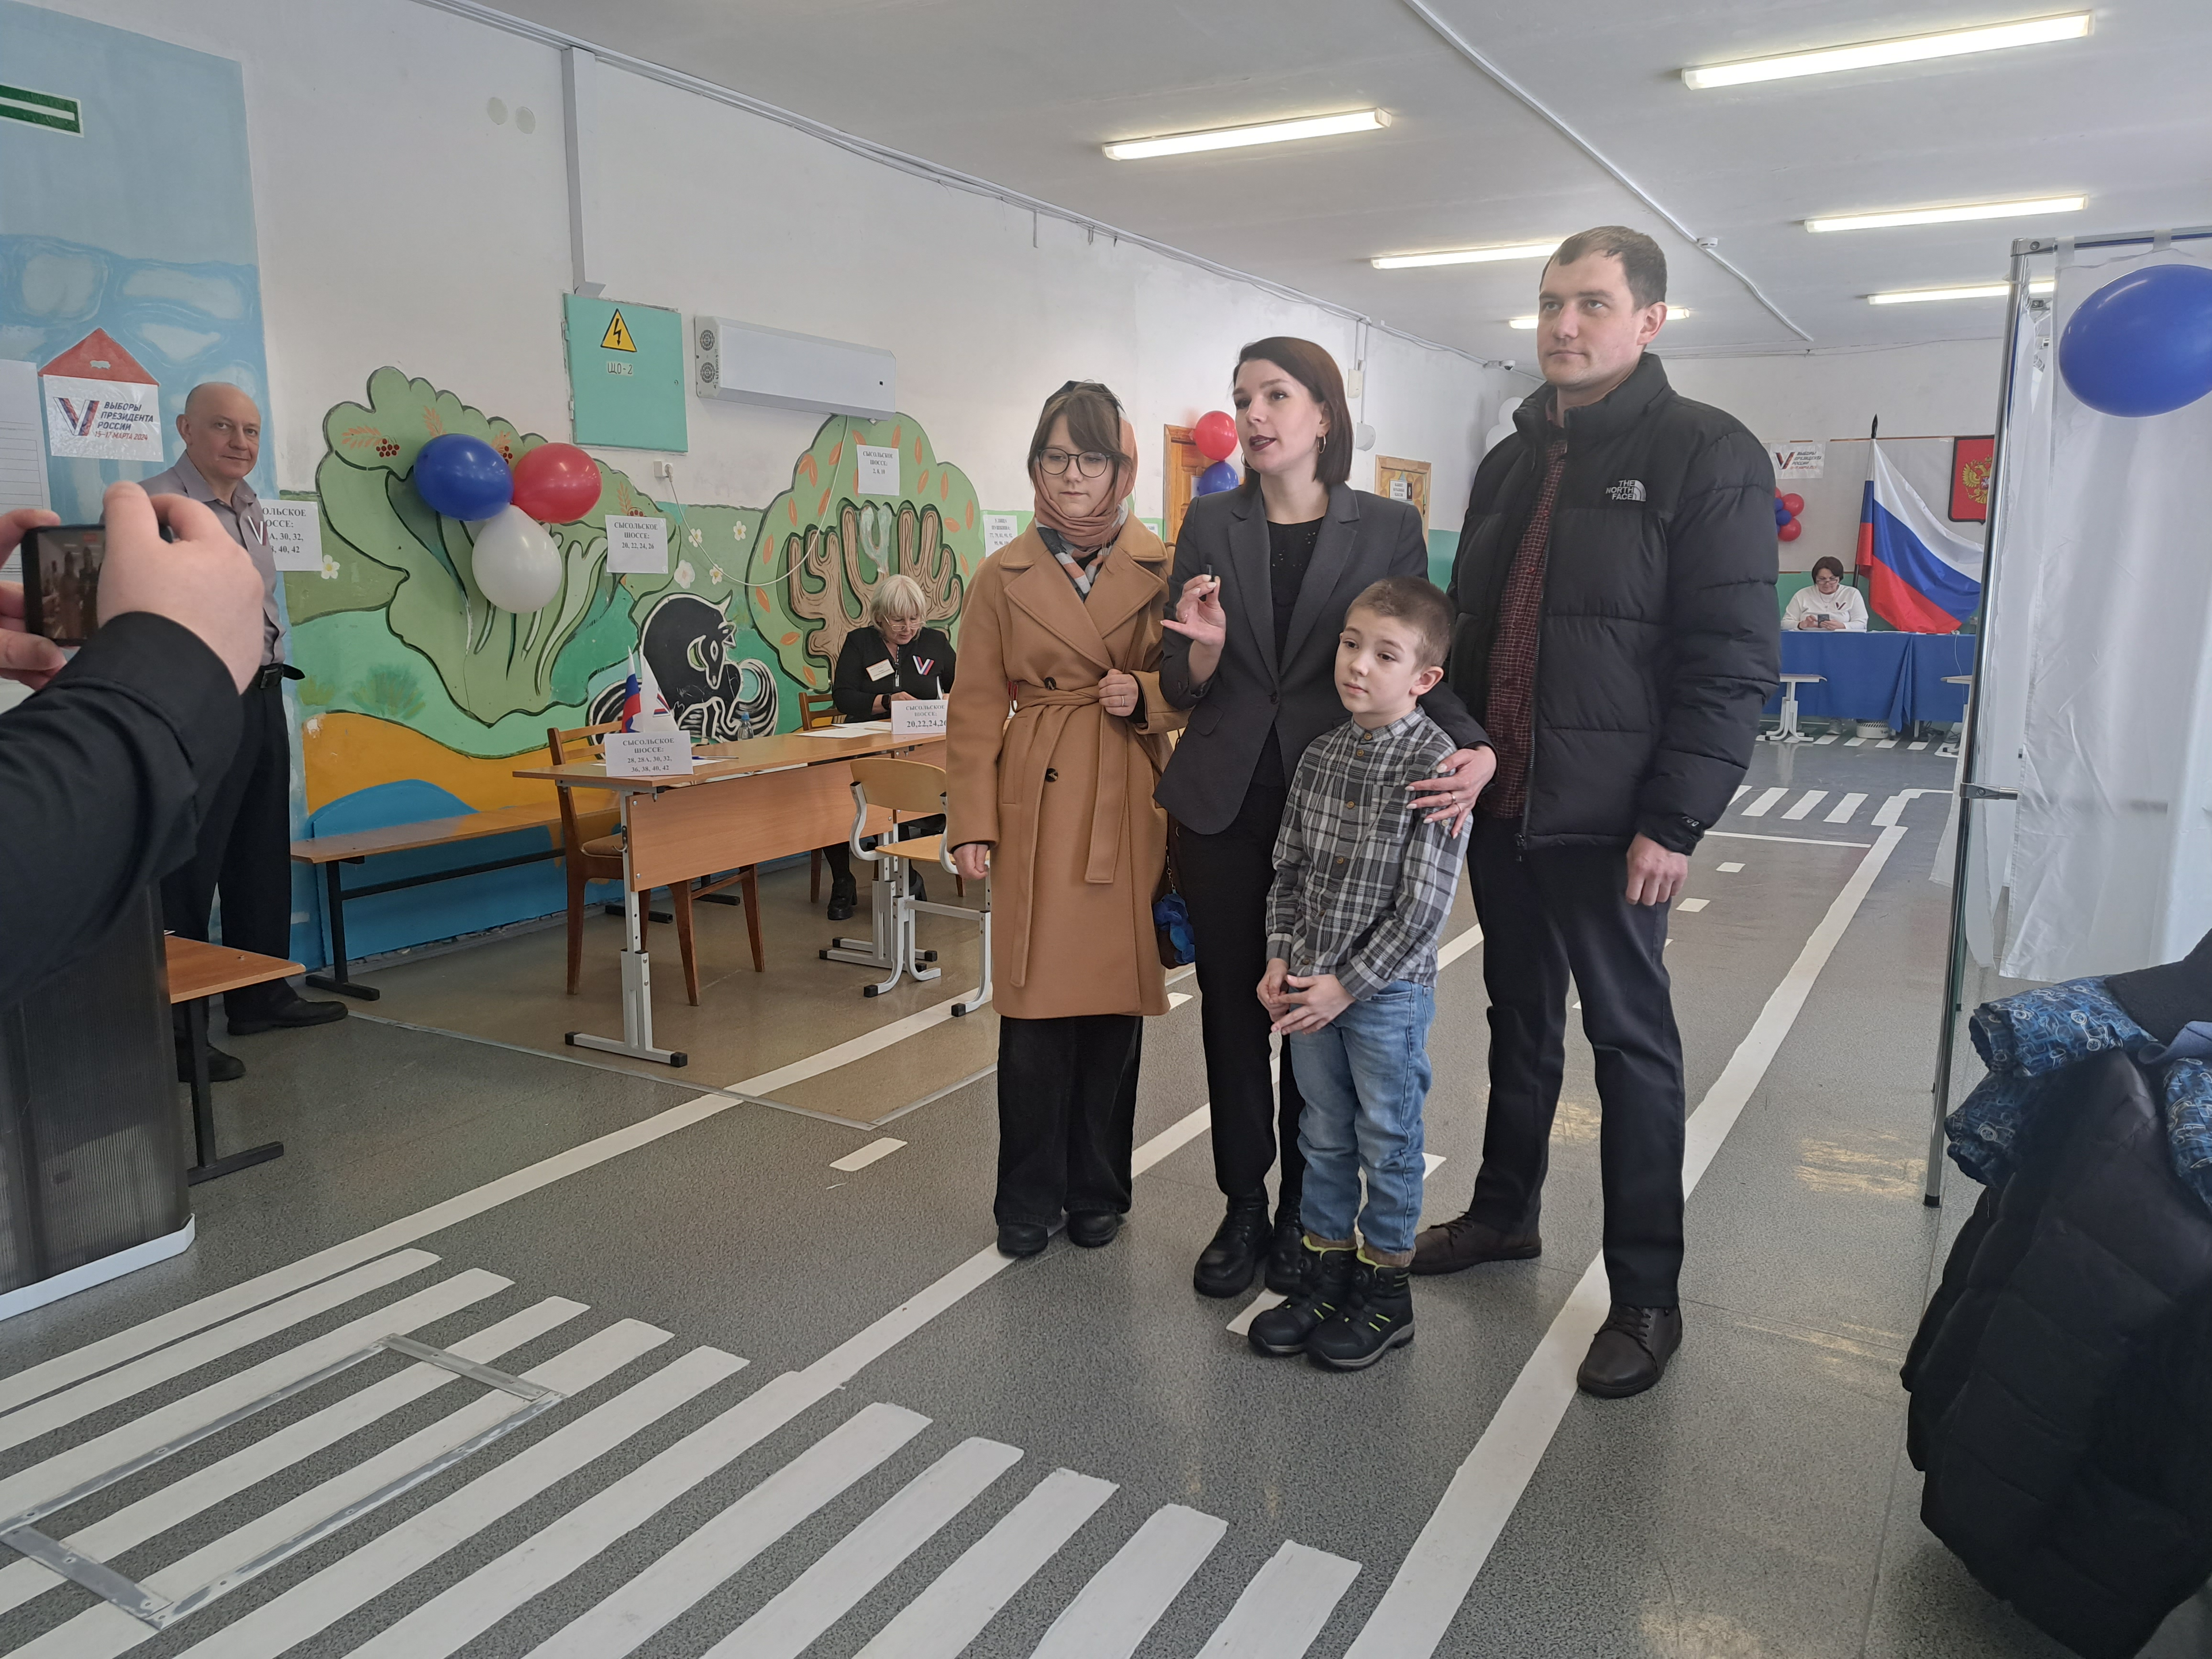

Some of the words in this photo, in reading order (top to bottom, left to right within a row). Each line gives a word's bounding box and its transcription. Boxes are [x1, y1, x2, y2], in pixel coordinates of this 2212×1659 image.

[608, 362, 632, 375] ЩО-2
[104, 402, 142, 411] ВЫБОРЫ
[100, 411, 154, 422] ПРЕЗИДЕНТА
[97, 421, 132, 431] РОССИИ
[263, 508, 306, 517] ОЛЬСКОЕ
[265, 520, 294, 528] ОССЕ:
[614, 522, 658, 530] СЫСОЛЬСКОЕ
